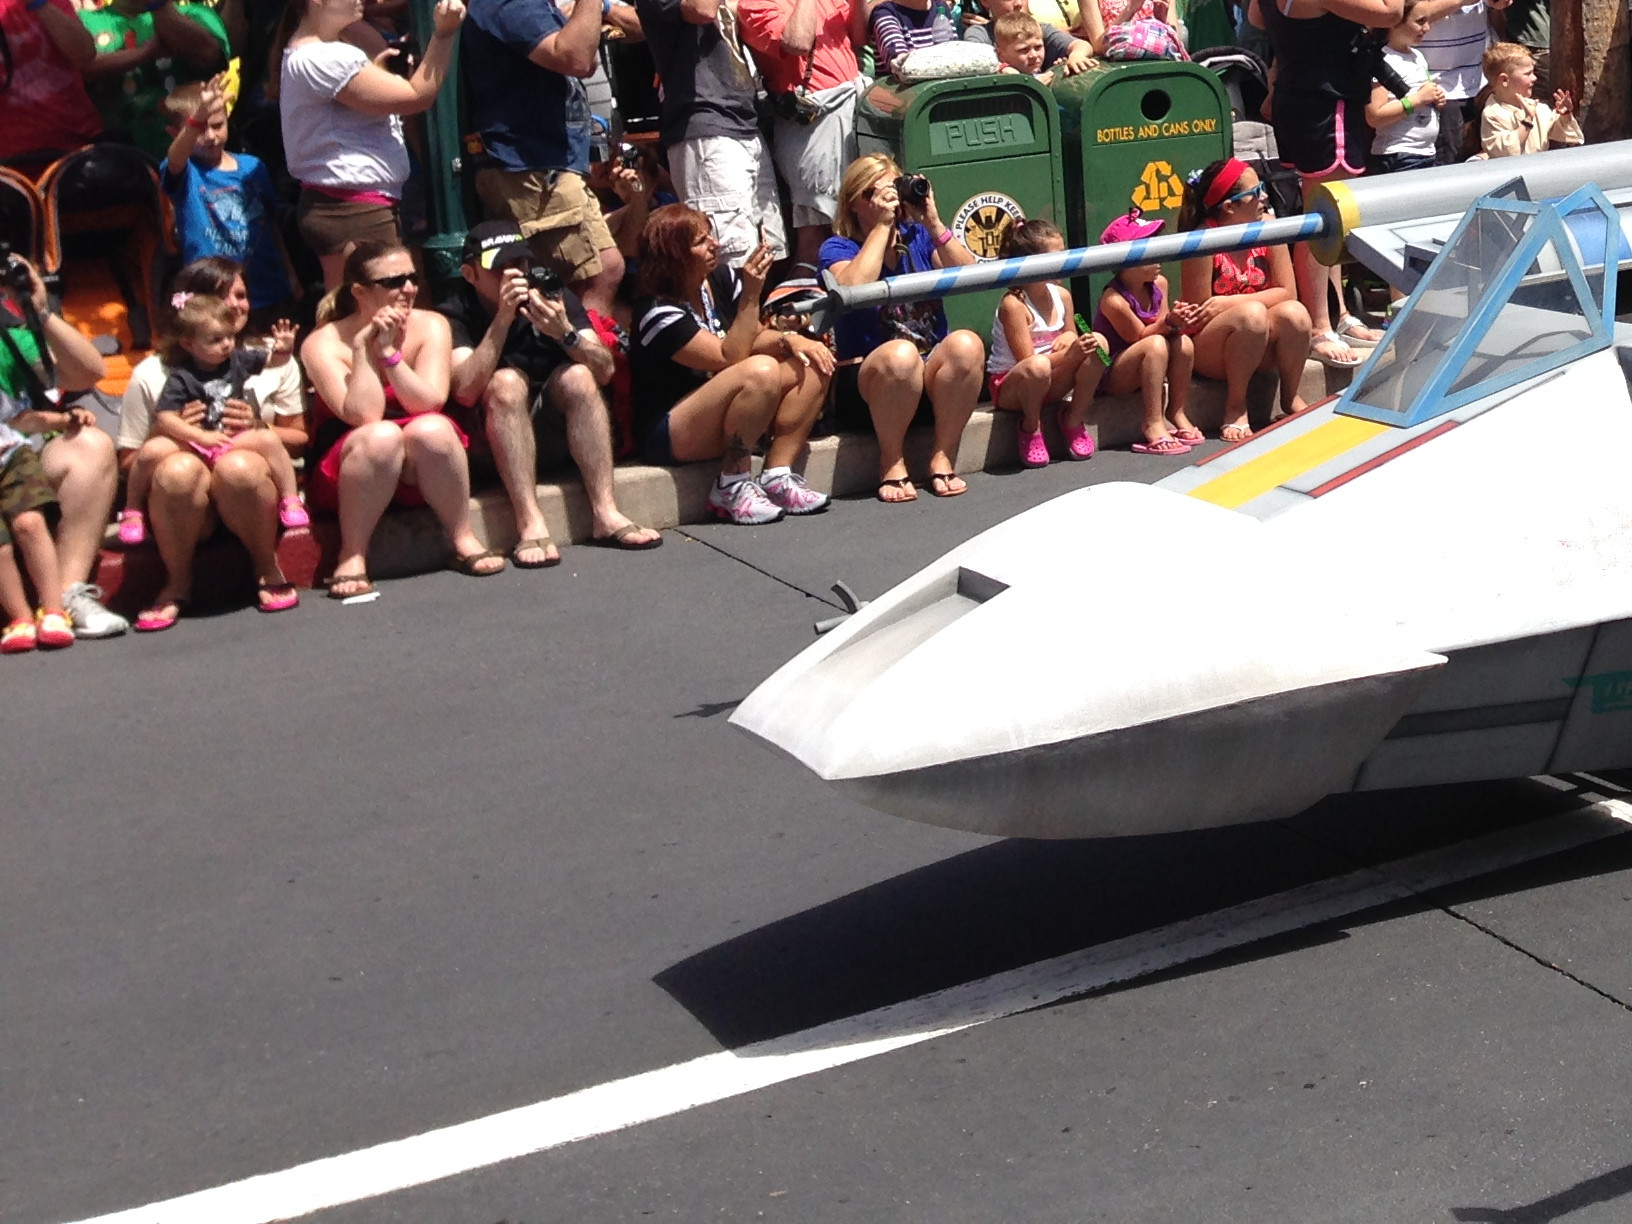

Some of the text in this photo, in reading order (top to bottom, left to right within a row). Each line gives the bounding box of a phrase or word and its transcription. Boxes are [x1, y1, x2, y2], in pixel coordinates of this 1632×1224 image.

[945, 116, 1016, 150] PUSH
[1097, 118, 1217, 142] BOTTLES AND CANS ONLY
[955, 199, 978, 230] PLEASE
[981, 196, 1004, 205] HELP
